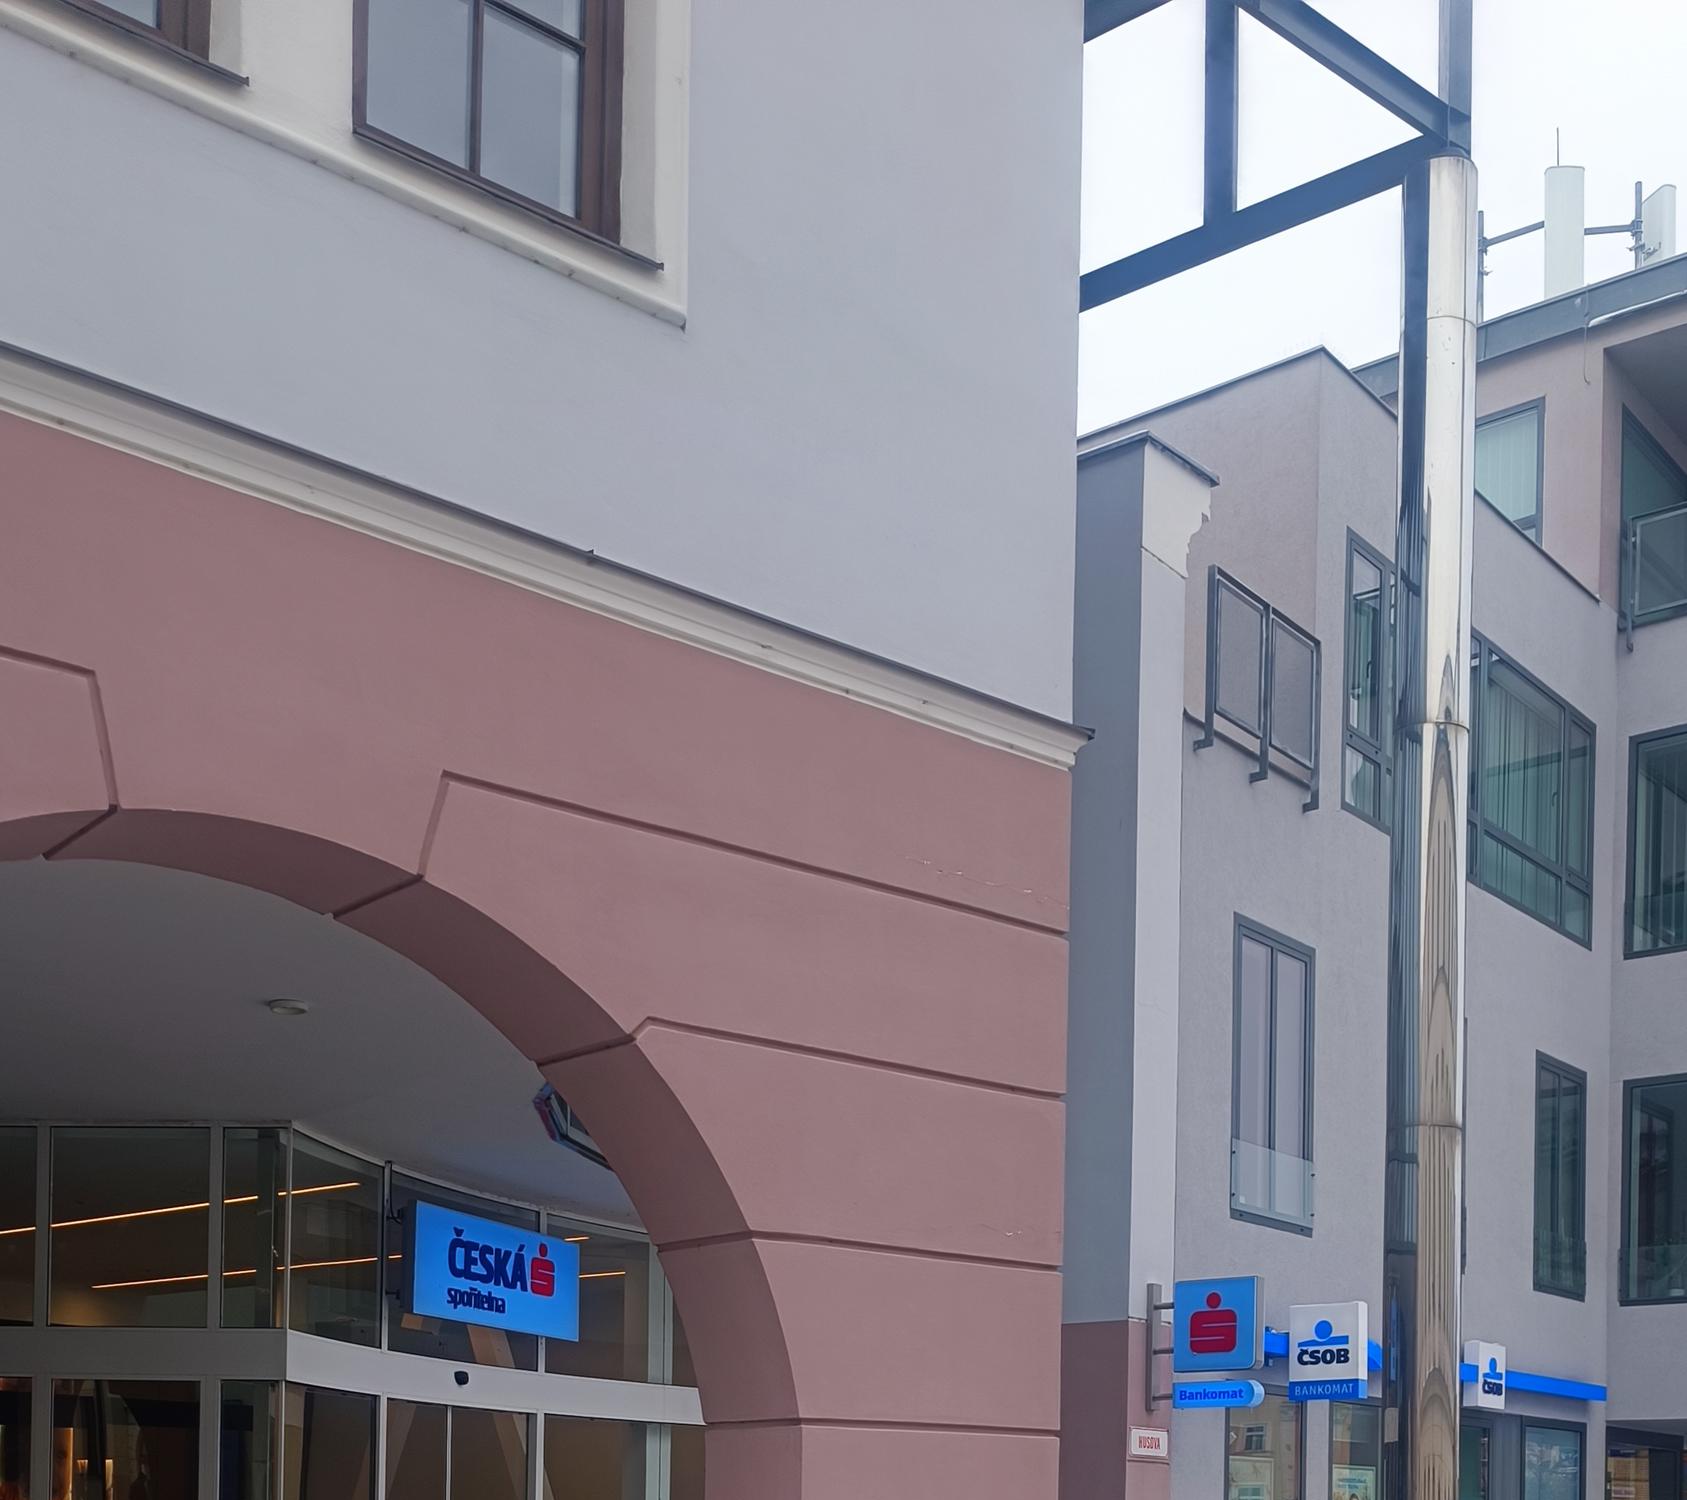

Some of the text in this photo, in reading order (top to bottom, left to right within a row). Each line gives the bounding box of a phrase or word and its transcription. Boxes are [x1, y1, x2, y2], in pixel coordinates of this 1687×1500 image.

[448, 1226, 528, 1292] ČESKÁ
[446, 1287, 506, 1314] spořitelna
[1297, 1348, 1350, 1366] ČSOB
[1179, 1388, 1244, 1401] Bankomat
[1294, 1383, 1355, 1397] BANKOMAT
[1138, 1435, 1161, 1450] HUSOVA
